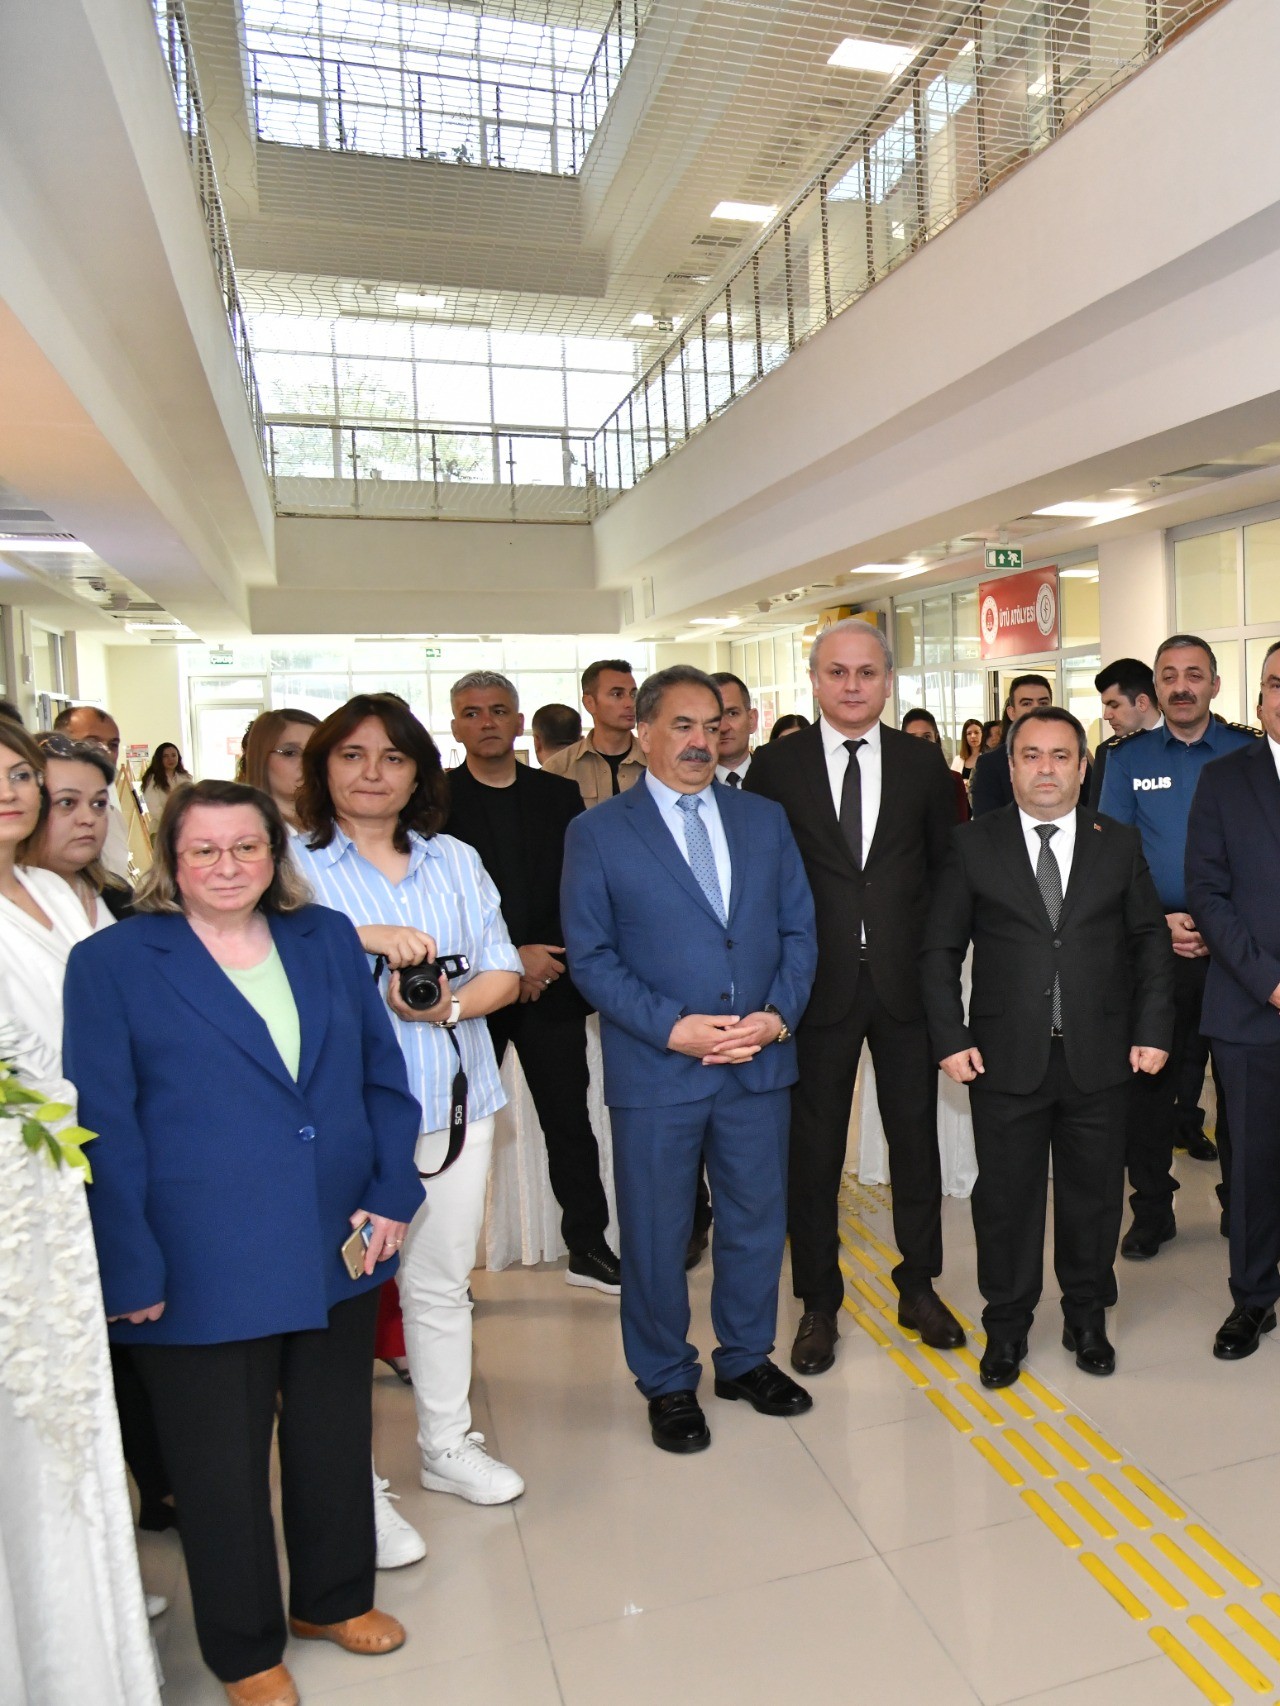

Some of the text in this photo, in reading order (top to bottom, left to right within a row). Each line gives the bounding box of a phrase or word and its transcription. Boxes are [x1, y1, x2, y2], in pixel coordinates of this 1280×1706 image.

[999, 607, 1010, 628] ÜTÜ
[1011, 602, 1036, 626] ATÖLYESİ
[455, 1104, 463, 1125] EOS
